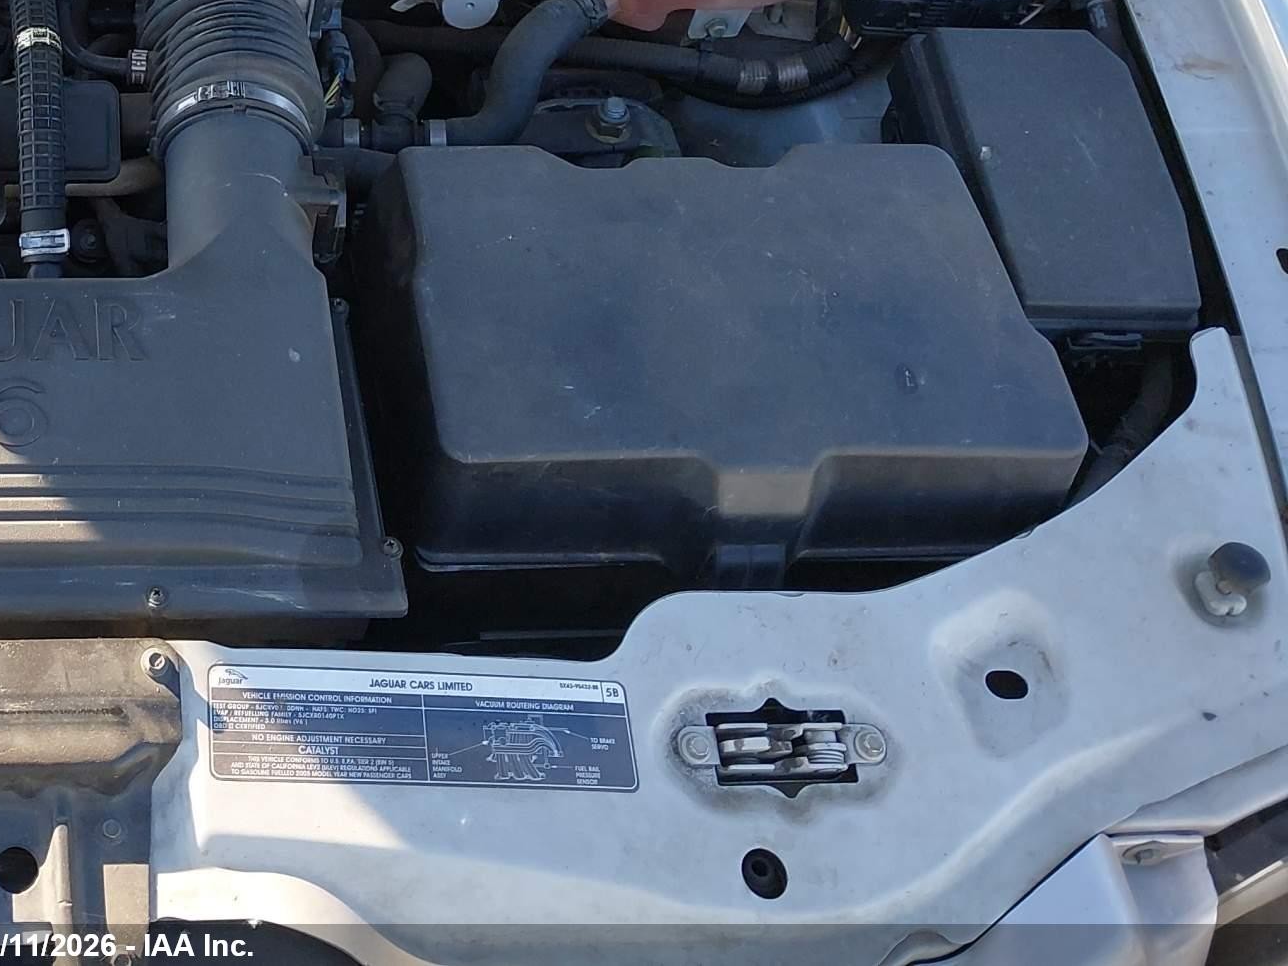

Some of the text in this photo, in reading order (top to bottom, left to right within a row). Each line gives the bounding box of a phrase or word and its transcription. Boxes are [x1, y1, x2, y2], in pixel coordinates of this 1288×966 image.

[218, 677, 243, 685] Jaguar
[369, 677, 473, 692] JAGUAR CARS LIMITED
[605, 687, 620, 698] 5B
[242, 691, 393, 704] VEHICLE EMISSION CONTROL INFORMATION
[228, 703, 249, 711] GROUP
[475, 700, 574, 711] VACUUM ROUTEING DIAGRAM
[235, 722, 265, 730] CERTIFIED
[252, 733, 387, 745] NO ENGINE ADJUSTMENT NECESSARY
[600, 737, 617, 745] BRAKE
[298, 745, 339, 755] CATALYST
[591, 743, 609, 751] SERVO
[262, 755, 283, 763] VEHICLE
[285, 756, 320, 764] CONFORMS
[432, 758, 451, 766] INTAKE
[271, 763, 306, 771] CALIFORNIA
[340, 765, 378, 773] REGULATIONS
[432, 765, 462, 773] MANIFOLD
[241, 769, 270, 777] GASOLINE
[311, 770, 332, 778] MODEL
[363, 772, 395, 780] PASSENGER
[396, 772, 412, 780] CARS
[575, 771, 601, 779] PRESSURE
[576, 777, 598, 785] SENSOR
